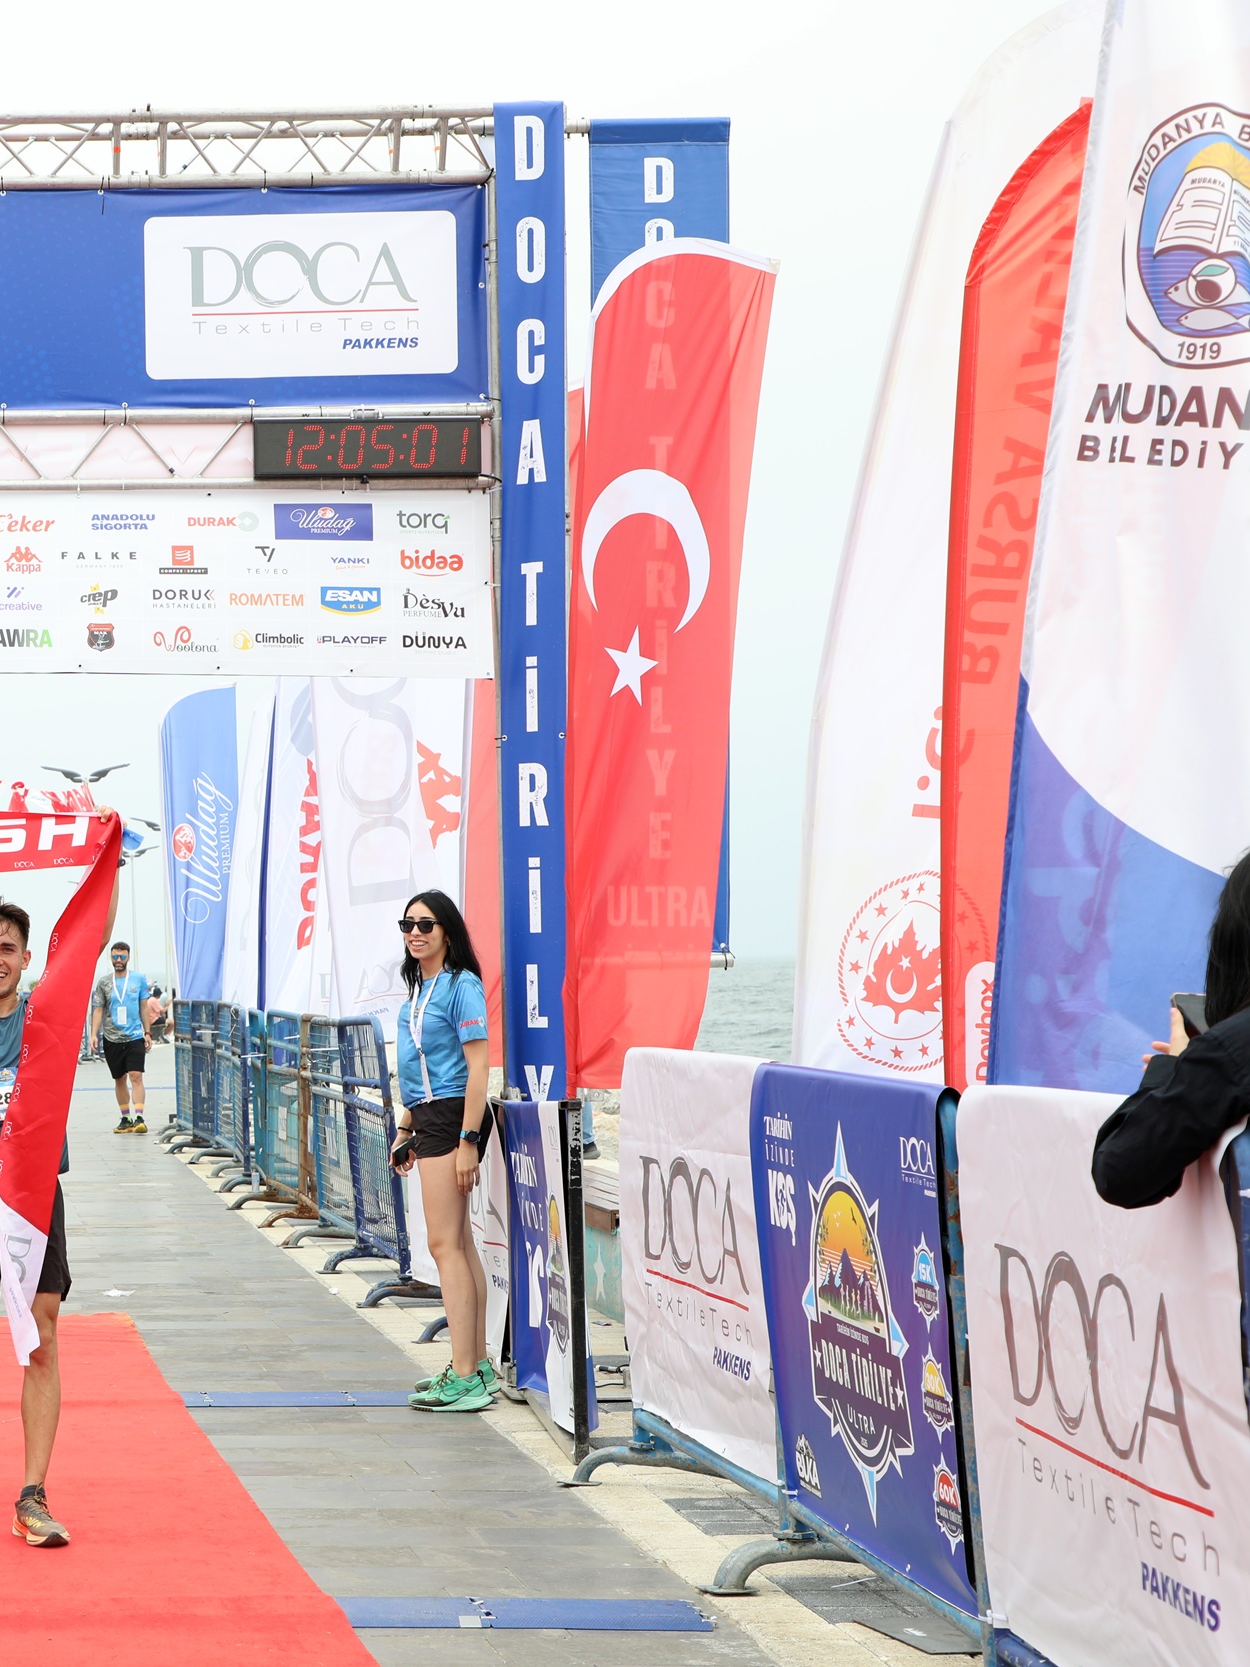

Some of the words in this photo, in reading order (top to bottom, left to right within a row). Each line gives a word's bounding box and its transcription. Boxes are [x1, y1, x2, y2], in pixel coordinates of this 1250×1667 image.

[1133, 112, 1225, 197] MUDANYA
[1190, 177, 1226, 189] MUDANYA
[183, 240, 418, 308] DOCA
[513, 115, 547, 485] DOCA
[192, 319, 323, 335] Textile
[338, 316, 420, 332] Tech
[342, 336, 419, 350] PAKKENS
[1176, 341, 1222, 361] 1919
[285, 423, 470, 470] 12:05:01
[91, 513, 156, 522] ANADOLU
[91, 521, 149, 531] SİGORTA
[187, 517, 237, 527] DURAK
[396, 510, 451, 535] torq
[60, 551, 138, 560] FALKE
[330, 557, 370, 565] YANKI
[5, 562, 42, 574] Kappa
[80, 588, 119, 608] crep
[152, 589, 216, 601] DORUK
[152, 602, 217, 610] HASTANELERİ
[229, 593, 305, 607] ROMATEM
[324, 589, 379, 603] ESAN
[402, 610, 442, 618] PERFUME
[255, 632, 305, 645] Climbolic
[322, 635, 388, 645] PLAYOFF
[402, 631, 468, 650] DÜNYA
[220, 812, 232, 875] PREMIUM
[606, 884, 712, 929] ULTRA
[763, 1111, 793, 1141] TARİHİN
[764, 1138, 796, 1168] İZİNDE
[899, 1136, 936, 1175] DOCA
[767, 1168, 797, 1247] KOŞ
[638, 1156, 750, 1296] DOCA
[644, 1281, 707, 1328] Textile
[708, 1307, 755, 1348] Tech
[712, 1346, 752, 1382] PAKKENS
[821, 1338, 852, 1390] DOCA
[851, 1347, 896, 1412] TİRİLYE
[994, 1243, 1211, 1491] DOCA
[925, 1372, 942, 1395] 30K
[846, 1403, 877, 1435] ULTRA
[939, 1483, 957, 1506] 60K
[1018, 1437, 1117, 1526] Textile
[1126, 1497, 1221, 1577] Tech
[1141, 1561, 1221, 1633] PAKKENS
